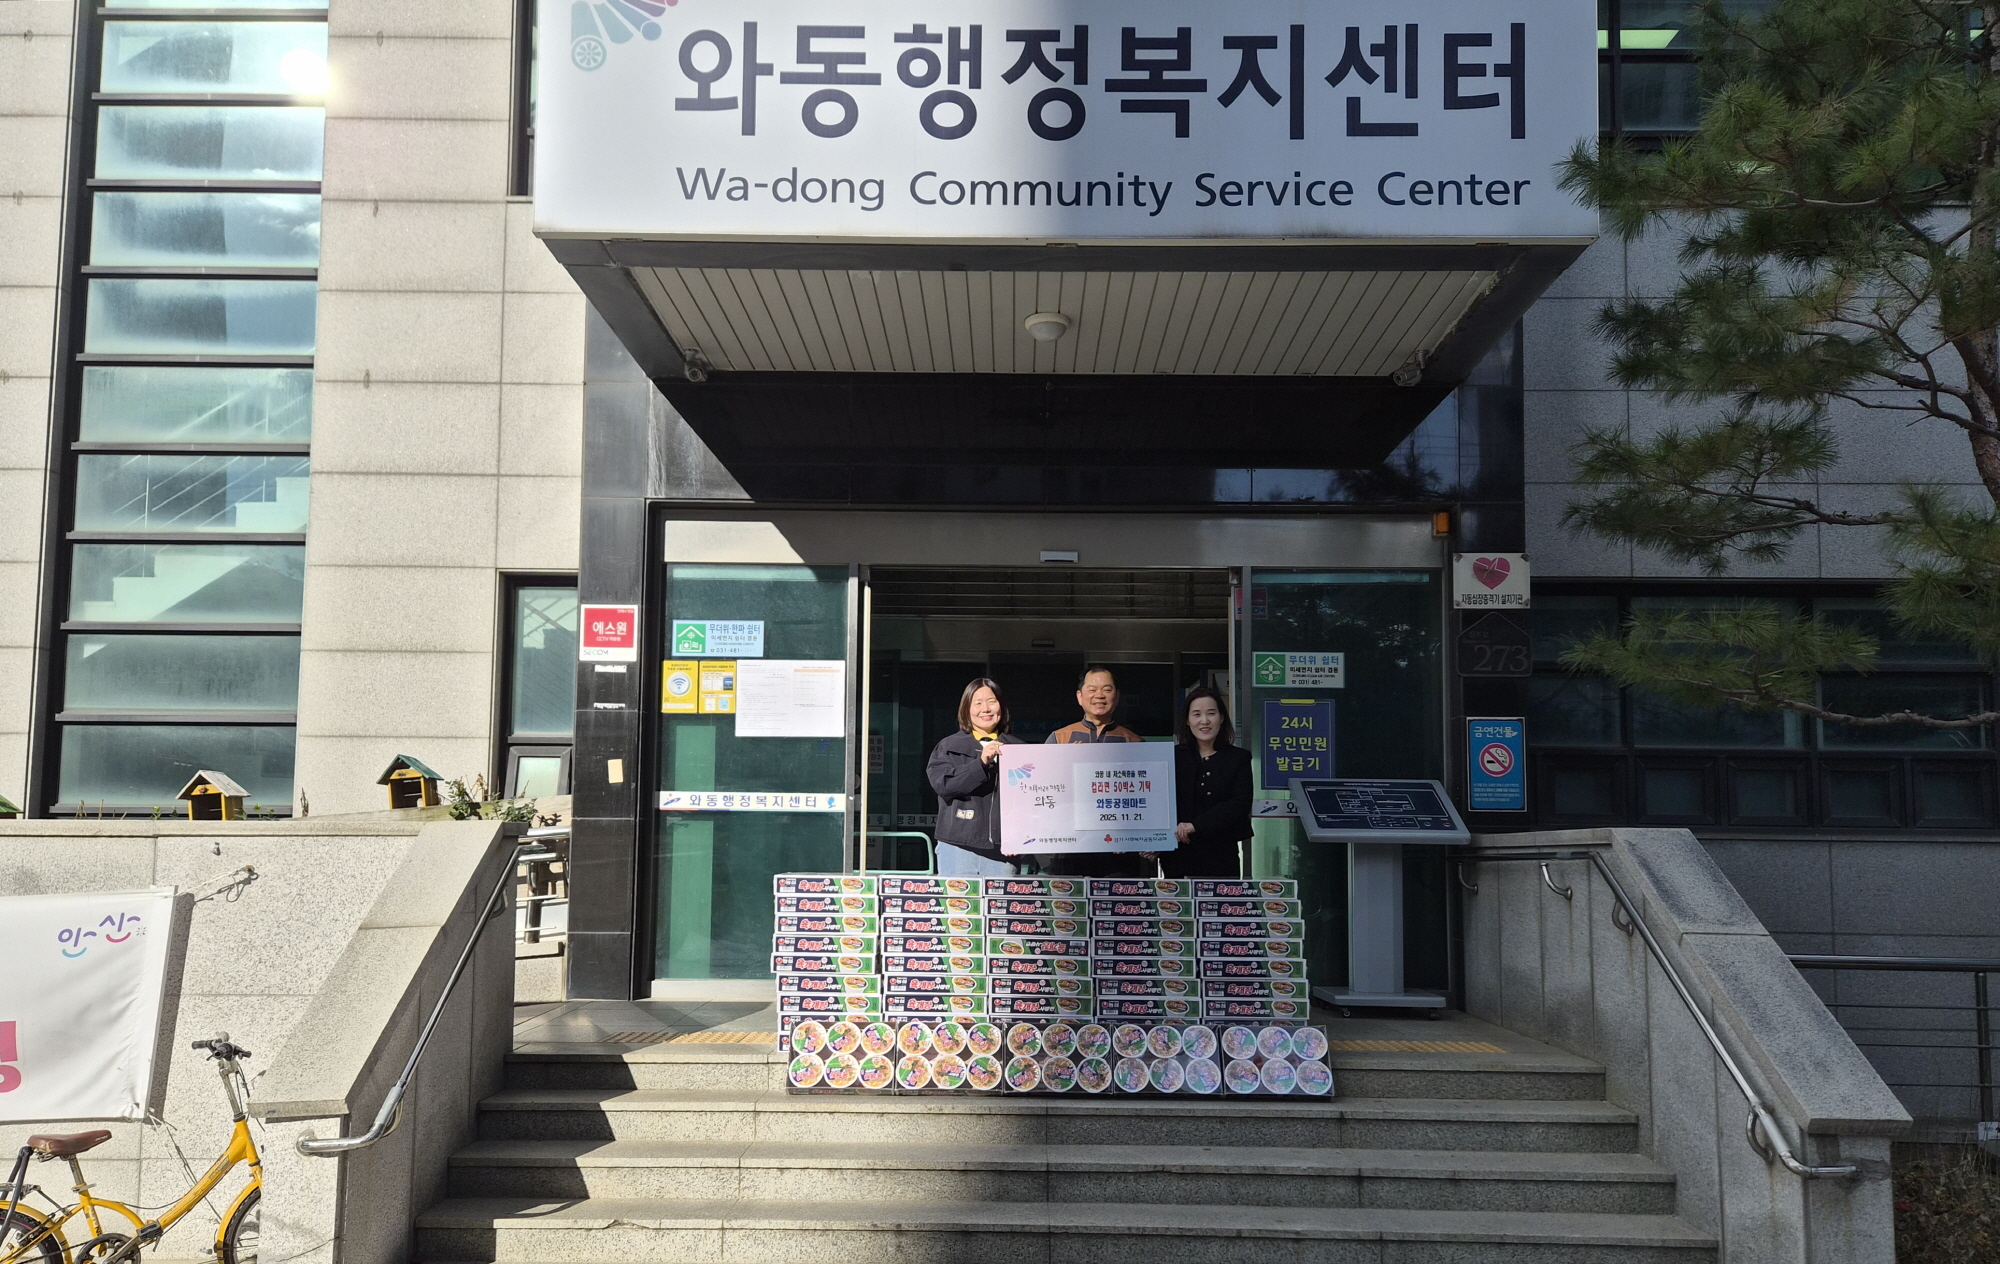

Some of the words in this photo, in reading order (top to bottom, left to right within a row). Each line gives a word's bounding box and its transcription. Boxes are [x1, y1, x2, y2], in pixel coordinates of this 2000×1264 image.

[675, 21, 1525, 141] 와동행정복지센터
[676, 167, 885, 211] Wa-dong
[909, 171, 1172, 217] Community
[1195, 171, 1353, 207] Service
[1378, 171, 1531, 207] Center
[1461, 594, 1499, 605] 자동심장충격기
[1501, 594, 1523, 605] 설치기관
[592, 621, 627, 635] 에스원
[709, 624, 745, 635] 무더위·한파
[1289, 655, 1316, 665] 무더위
[1321, 655, 1339, 665] 쉼터
[1473, 645, 1529, 672] 273
[1281, 717, 1313, 730] 24시
[1473, 726, 1514, 738] 금연건물
[1269, 737, 1327, 751] 무인민원
[1276, 757, 1320, 771] 발급기
[1095, 770, 1104, 778] 와동
[1106, 770, 1111, 778] 내
[1137, 770, 1147, 778] 위한
[1091, 781, 1110, 793] 컵라면
[1113, 781, 1135, 793] 50박스
[1139, 780, 1151, 792] 기탁
[689, 794, 817, 808] 와동행정복지센터
[1034, 795, 1056, 809] 와동
[1096, 798, 1147, 809] 와동공원마트
[1099, 813, 1118, 821] 2025.
[1121, 813, 1131, 821] 11.
[1134, 813, 1144, 821] 21.
[798, 880, 824, 892] 육개장
[903, 881, 929, 893] 육개장
[1006, 882, 1032, 894] 육개장
[1112, 883, 1137, 895] 육개장
[1216, 884, 1242, 896] 육개장
[799, 899, 825, 911] 육개장
[904, 900, 930, 912] 육개장
[1009, 902, 1035, 914] 육개장
[1114, 903, 1140, 915] 육개장
[1220, 904, 1246, 916] 육개장
[800, 919, 826, 931] 육개장
[905, 920, 931, 932] 육개장
[1010, 921, 1035, 933] 육개장
[1116, 923, 1142, 935] 육개장
[1224, 924, 1250, 936] 육개장
[58, 912, 141, 958] 안산
[797, 939, 823, 951] 육개장
[906, 939, 932, 951] 육개장
[1116, 942, 1142, 954] 육개장
[1222, 943, 1248, 955] 육개장
[796, 958, 821, 970] 육개장
[907, 959, 933, 971] 육개장
[1011, 961, 1037, 973] 육개장
[1115, 962, 1141, 974] 육개장
[1225, 963, 1251, 975] 육개장
[801, 978, 827, 990] 육개장
[910, 978, 935, 990] 육개장
[1013, 981, 1039, 993] 육개장
[1120, 982, 1146, 994] 육개장
[1227, 984, 1253, 996] 육개장
[802, 998, 828, 1010] 육개장
[907, 998, 933, 1010] 육개장
[1013, 1000, 1039, 1012] 육개장
[1121, 1002, 1147, 1014] 육개장
[1228, 1003, 1254, 1015] 육개장
